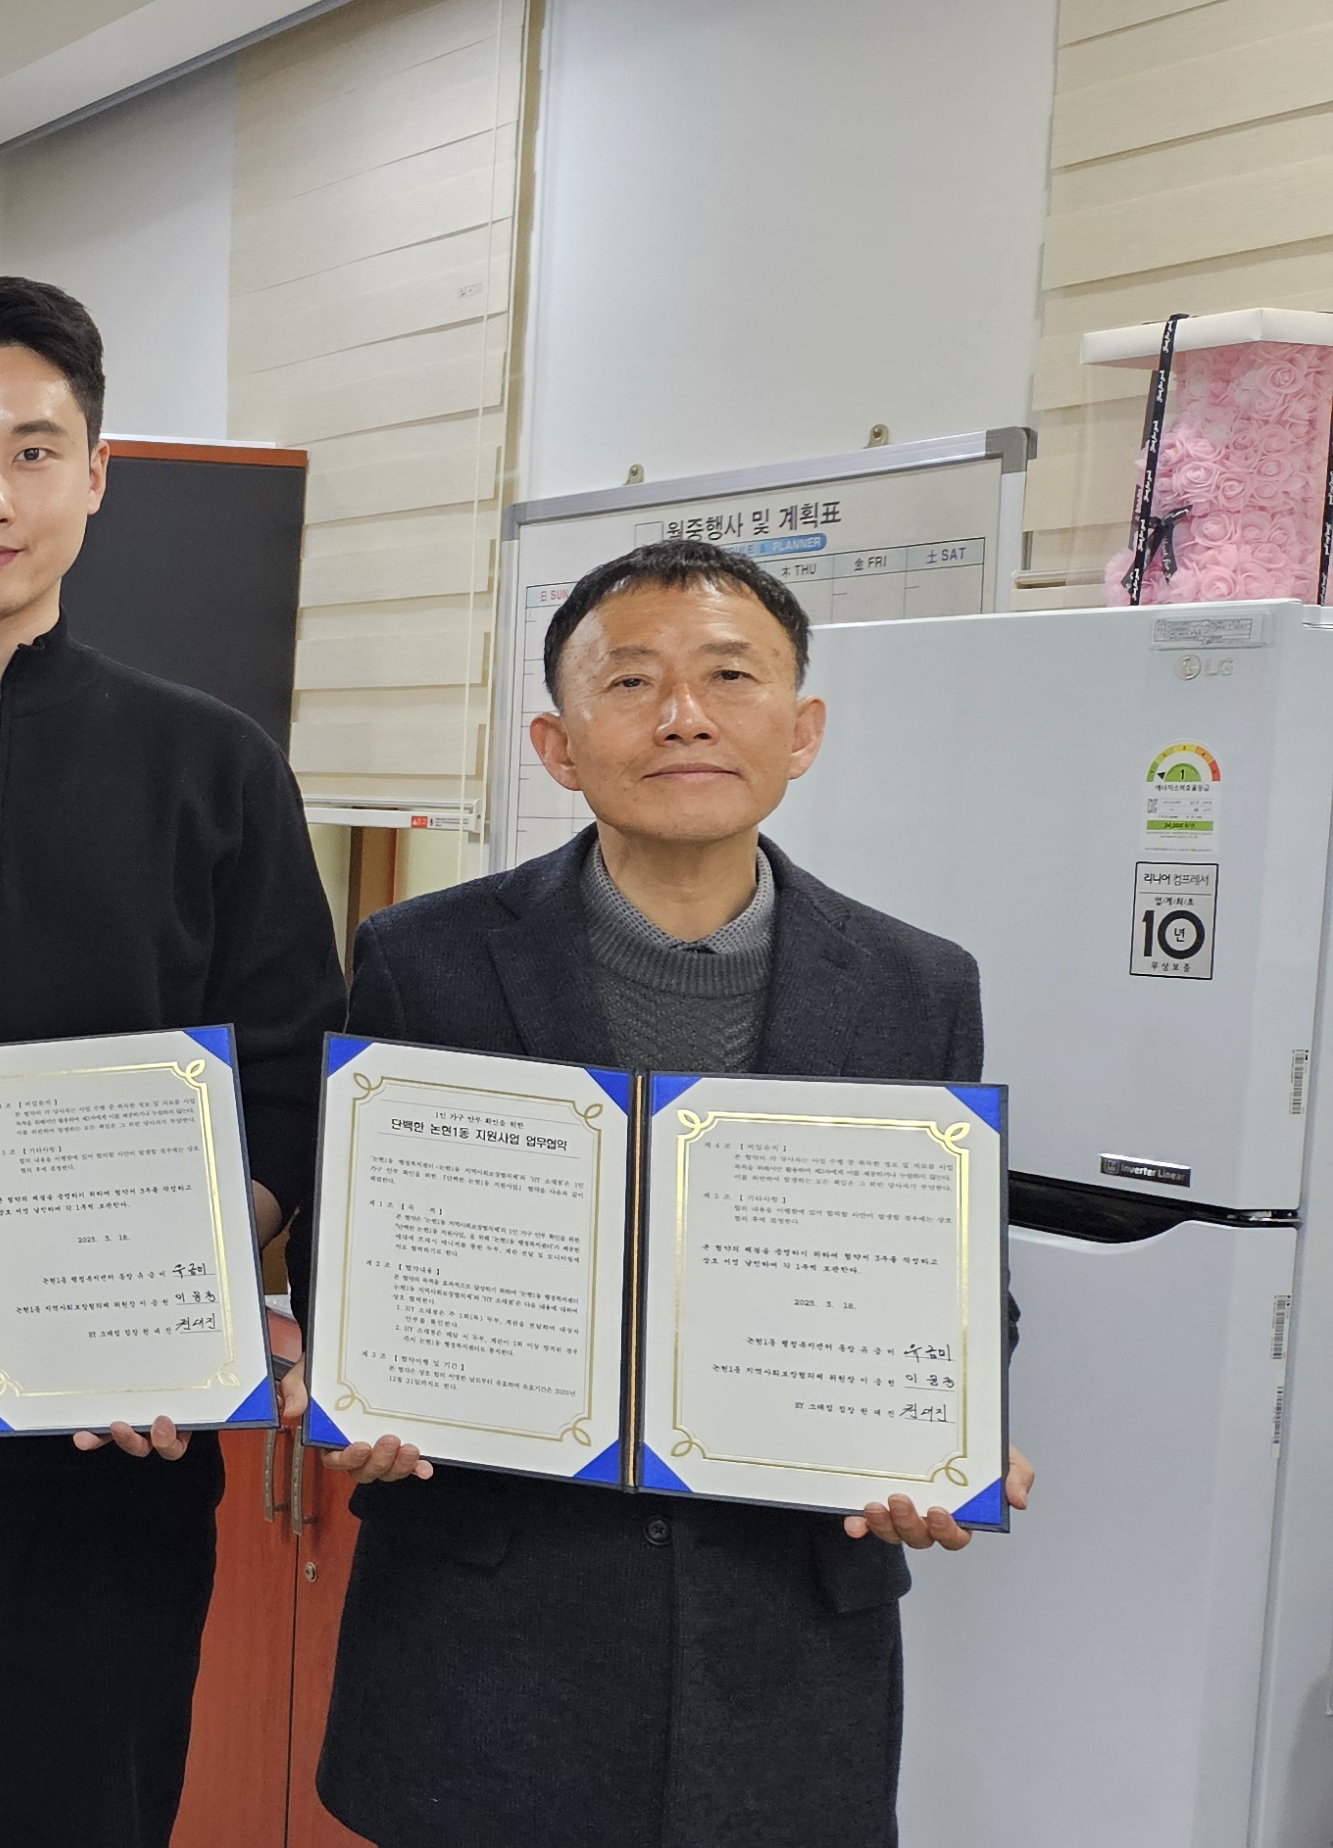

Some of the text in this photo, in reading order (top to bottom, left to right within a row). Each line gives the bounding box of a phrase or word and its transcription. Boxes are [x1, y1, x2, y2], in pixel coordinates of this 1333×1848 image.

[752, 509, 769, 535] 및
[779, 501, 841, 530] 계획표
[772, 536, 822, 551] PLANNER
[868, 556, 887, 568] FRI
[926, 547, 966, 564] 土 SAT
[794, 563, 816, 575] THU
[1204, 657, 1233, 677] LG
[1180, 768, 1185, 780] 1
[1144, 873, 1209, 886] 리니어 컴프레서
[1142, 910, 1205, 959] 10
[1174, 928, 1185, 942] 년
[392, 1119, 567, 1151] 단백한 논현1동 지원사업 업무협약
[1120, 1163, 1186, 1182] Inverter Linear
